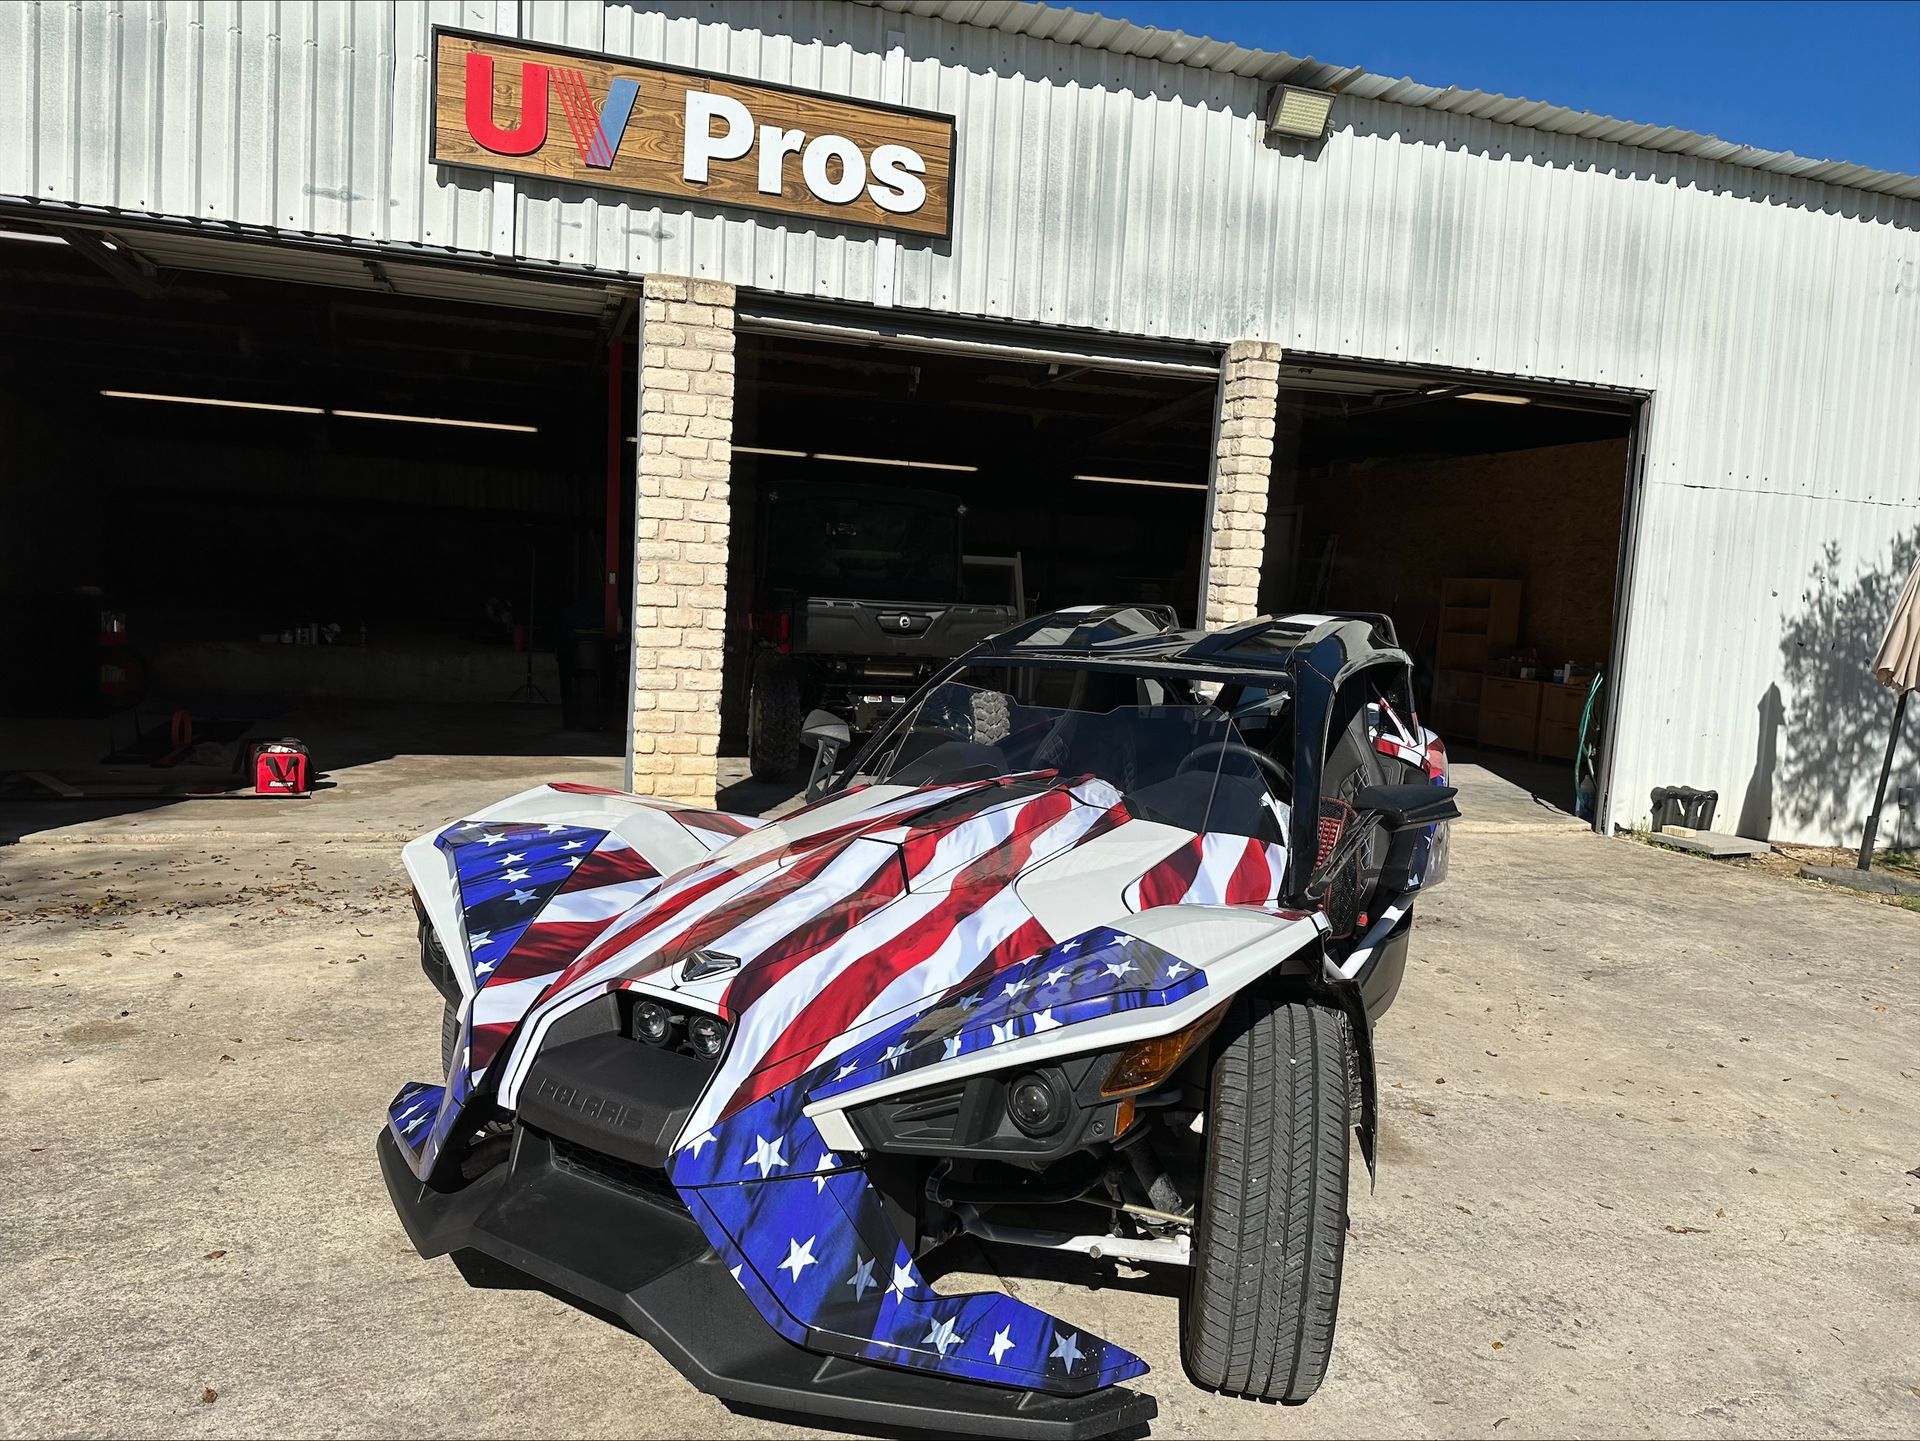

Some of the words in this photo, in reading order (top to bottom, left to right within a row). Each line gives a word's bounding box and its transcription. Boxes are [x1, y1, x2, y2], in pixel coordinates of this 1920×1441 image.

[464, 53, 640, 168] UV
[684, 90, 928, 213] Pros
[536, 1077, 644, 1129] POLARIS
